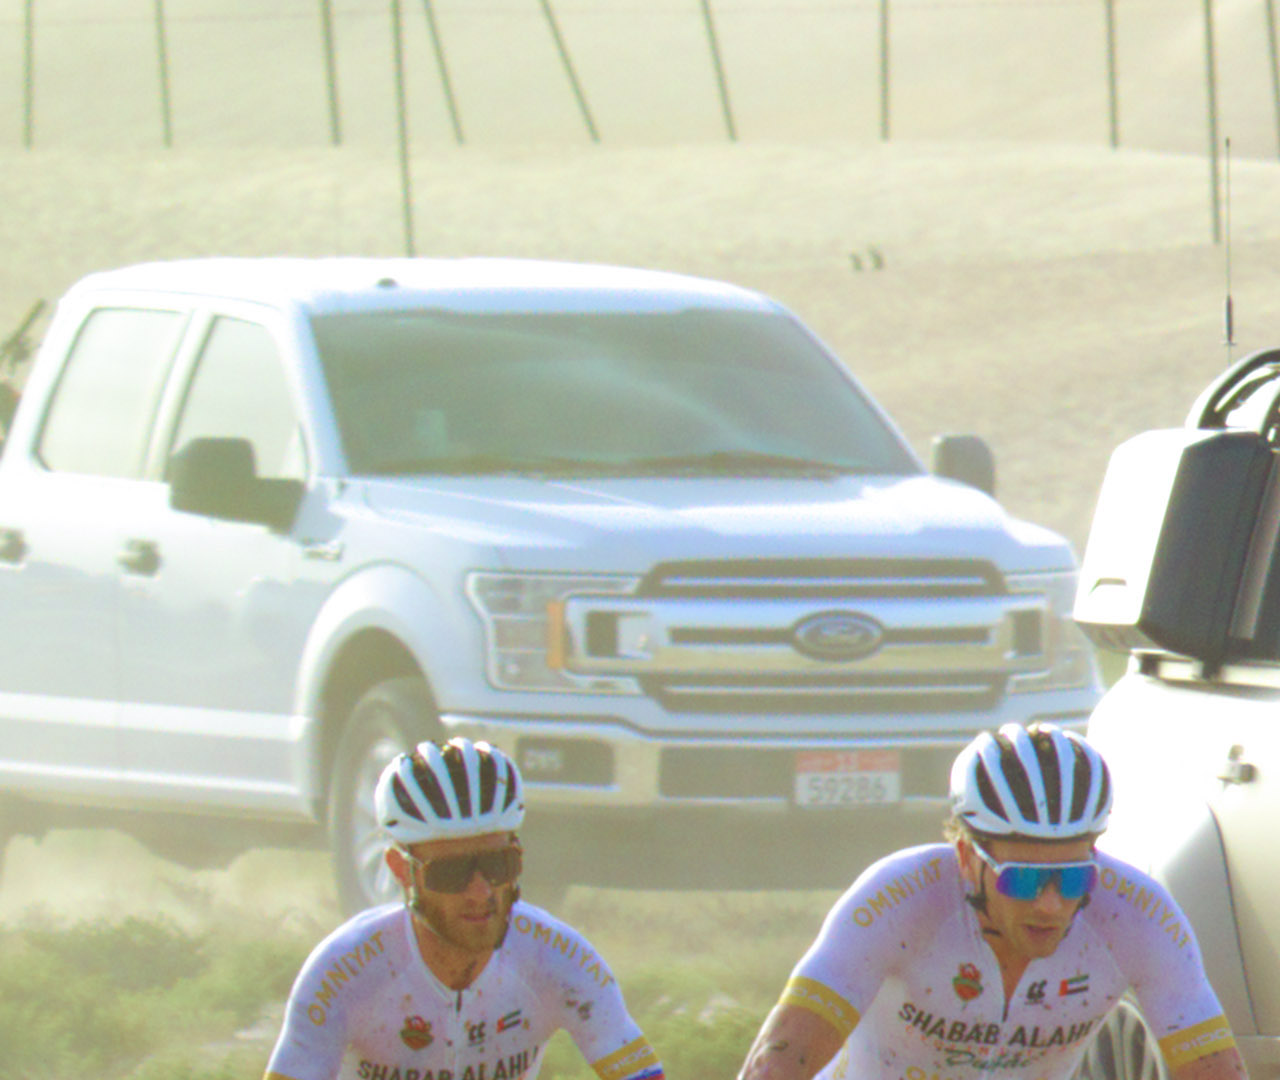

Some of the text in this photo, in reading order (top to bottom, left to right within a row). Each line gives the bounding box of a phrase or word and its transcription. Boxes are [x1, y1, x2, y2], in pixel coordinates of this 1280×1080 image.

[853, 858, 942, 928] OMNIYAT
[1100, 867, 1191, 949] OMNIYAT
[307, 931, 385, 1026] OMNIYAT
[515, 915, 612, 987] OMNIYAT
[899, 1002, 1000, 1045] SHABAB
